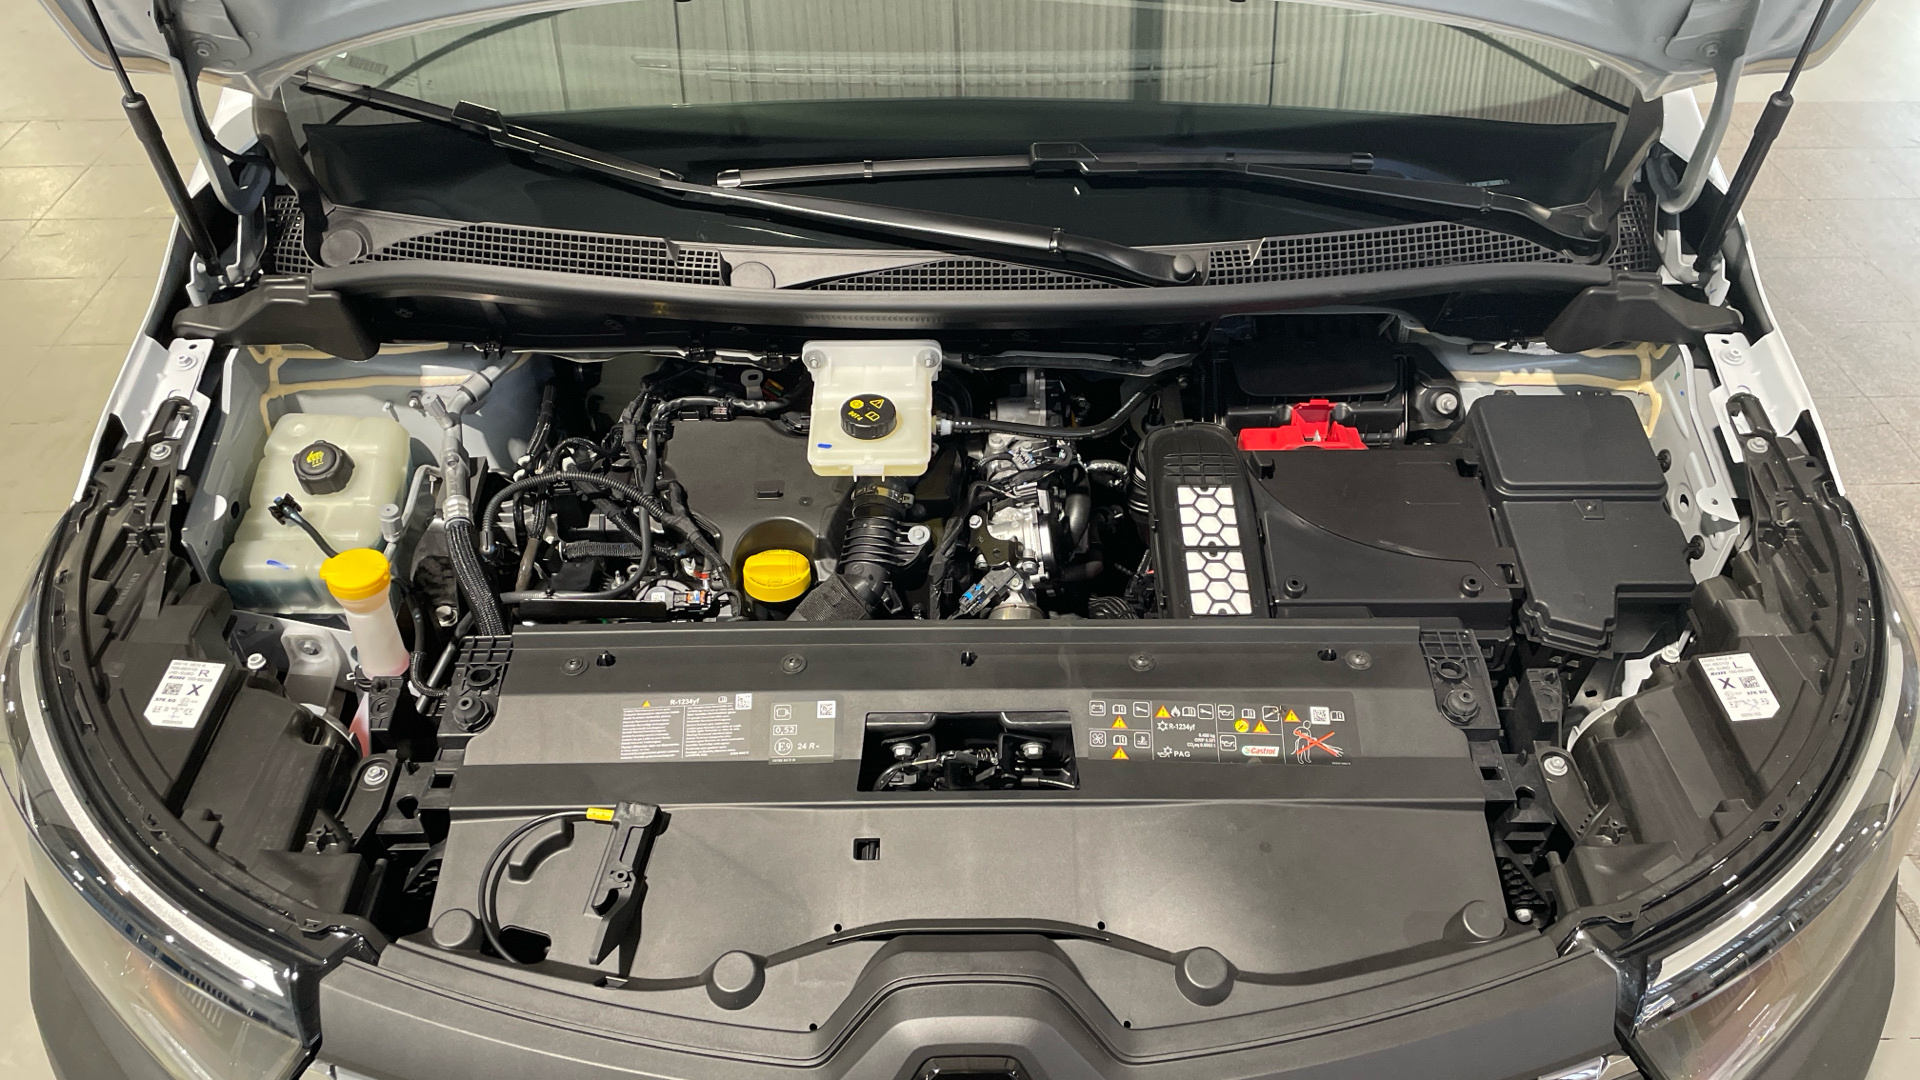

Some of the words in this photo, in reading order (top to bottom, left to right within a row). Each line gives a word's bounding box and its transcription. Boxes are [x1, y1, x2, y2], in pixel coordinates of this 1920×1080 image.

[1732, 661, 1743, 669] L
[198, 669, 210, 677] R
[1717, 677, 1736, 689] X
[186, 684, 204, 696] X
[670, 697, 700, 706] R-1234yf
[775, 726, 795, 735] 0,52
[1168, 723, 1195, 732] R-1234yf
[778, 742, 791, 752] E9
[797, 742, 807, 750] 24
[1250, 746, 1276, 755] Castrol
